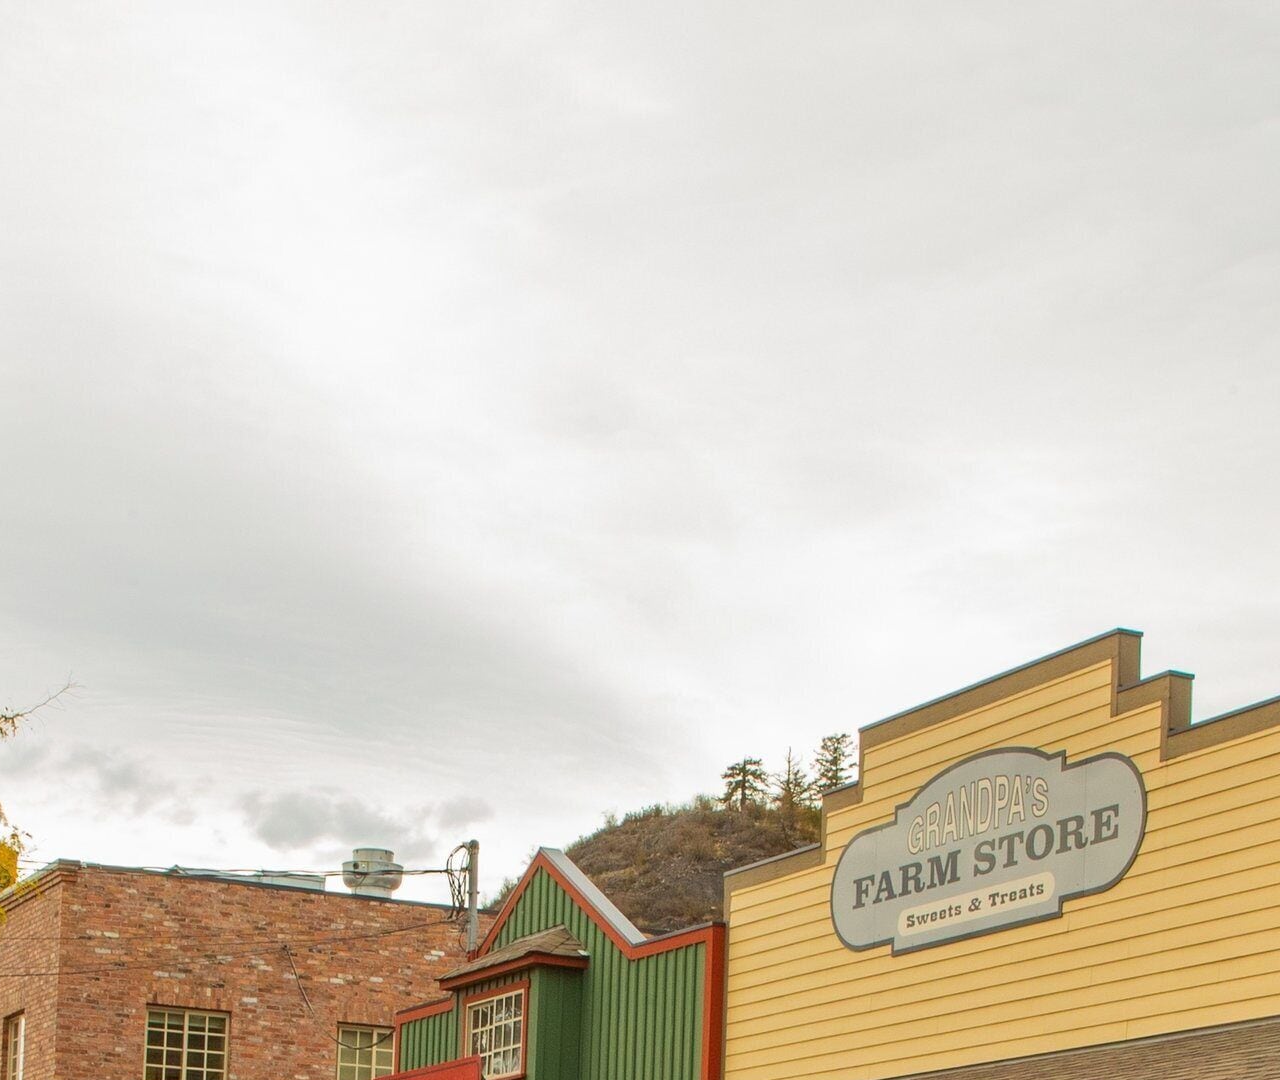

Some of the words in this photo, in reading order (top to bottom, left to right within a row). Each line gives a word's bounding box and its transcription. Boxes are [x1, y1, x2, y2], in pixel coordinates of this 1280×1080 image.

[907, 774, 1049, 855] GRANDPA'S
[852, 850, 962, 910] FARM
[973, 804, 1120, 877] STORE
[906, 904, 962, 928] Sweets
[968, 898, 982, 912] &
[989, 882, 1045, 907] Treats
